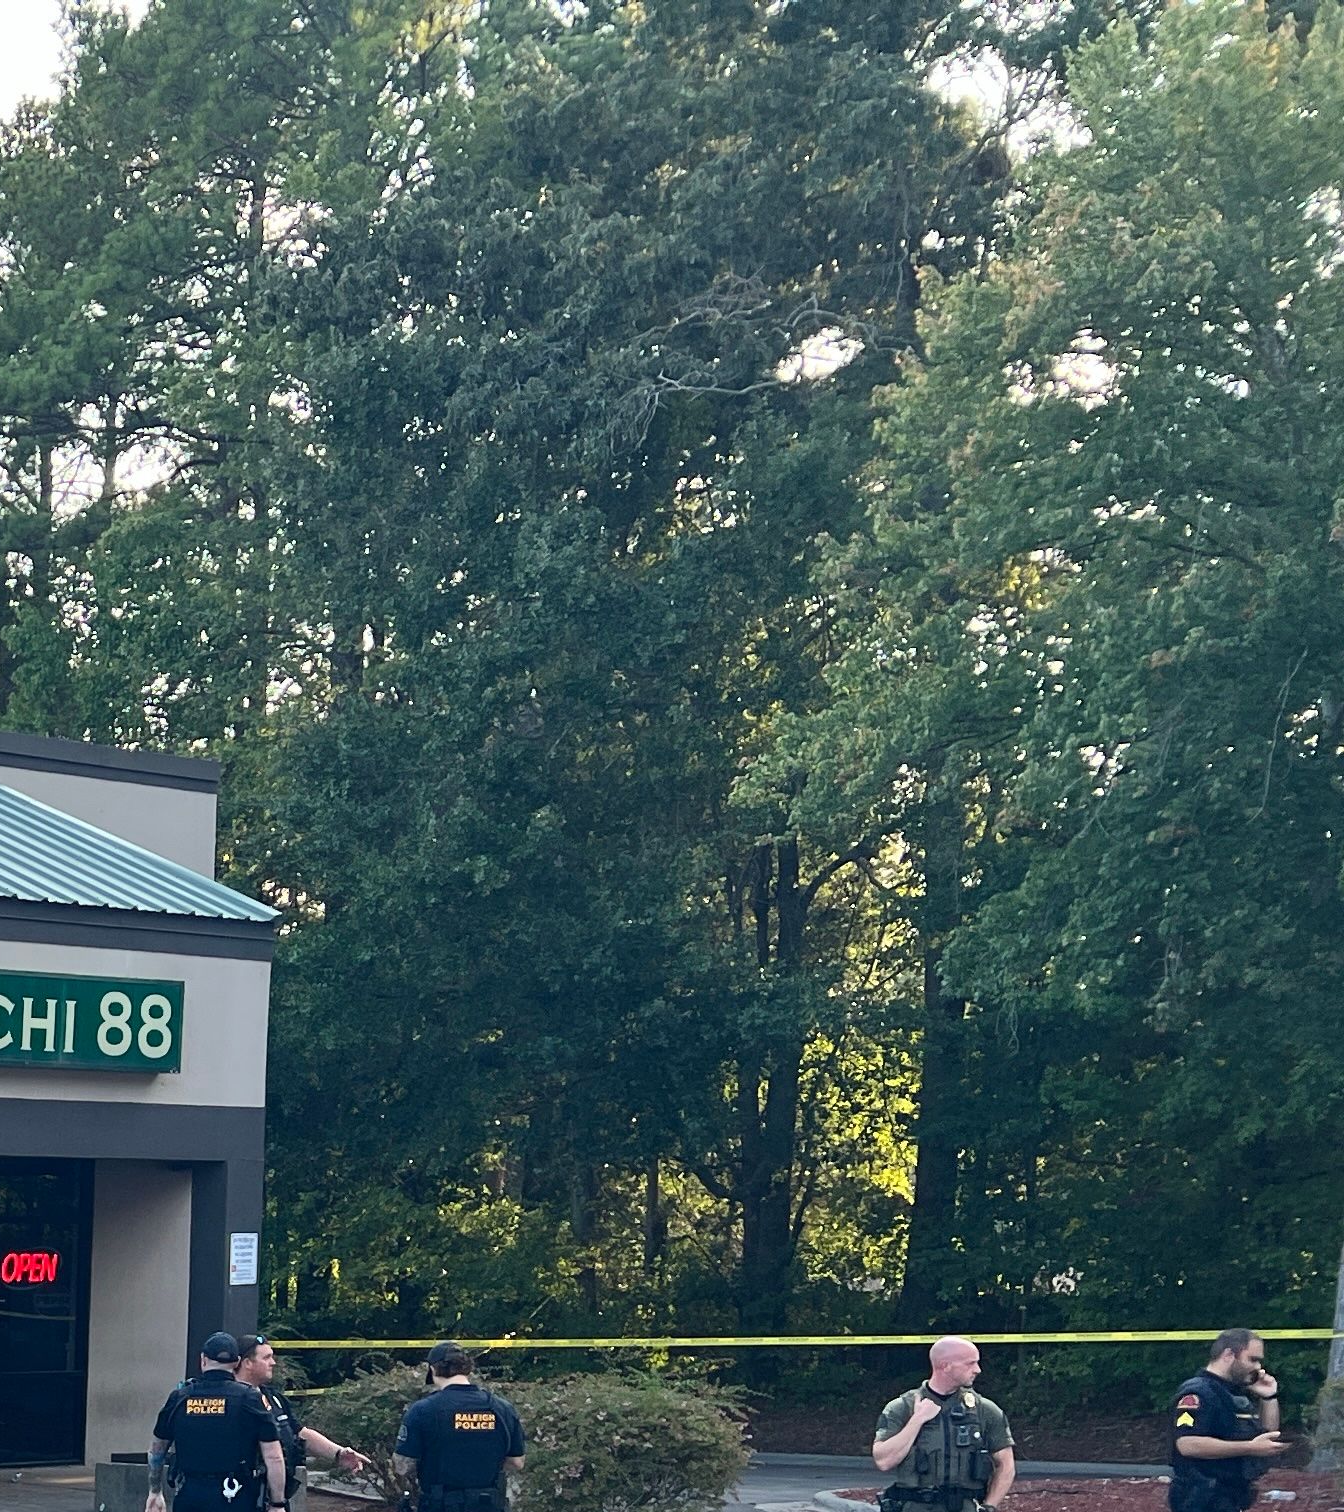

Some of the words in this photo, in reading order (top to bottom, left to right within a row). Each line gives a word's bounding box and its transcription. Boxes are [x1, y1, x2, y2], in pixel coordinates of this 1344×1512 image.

[96, 991, 173, 1059] 88
[1, 1253, 58, 1283] OPEN
[186, 1398, 226, 1407] RALEIGH
[186, 1406, 225, 1414] POLICE
[454, 1413, 496, 1421] RALEIGH
[454, 1421, 496, 1429] POLICE
